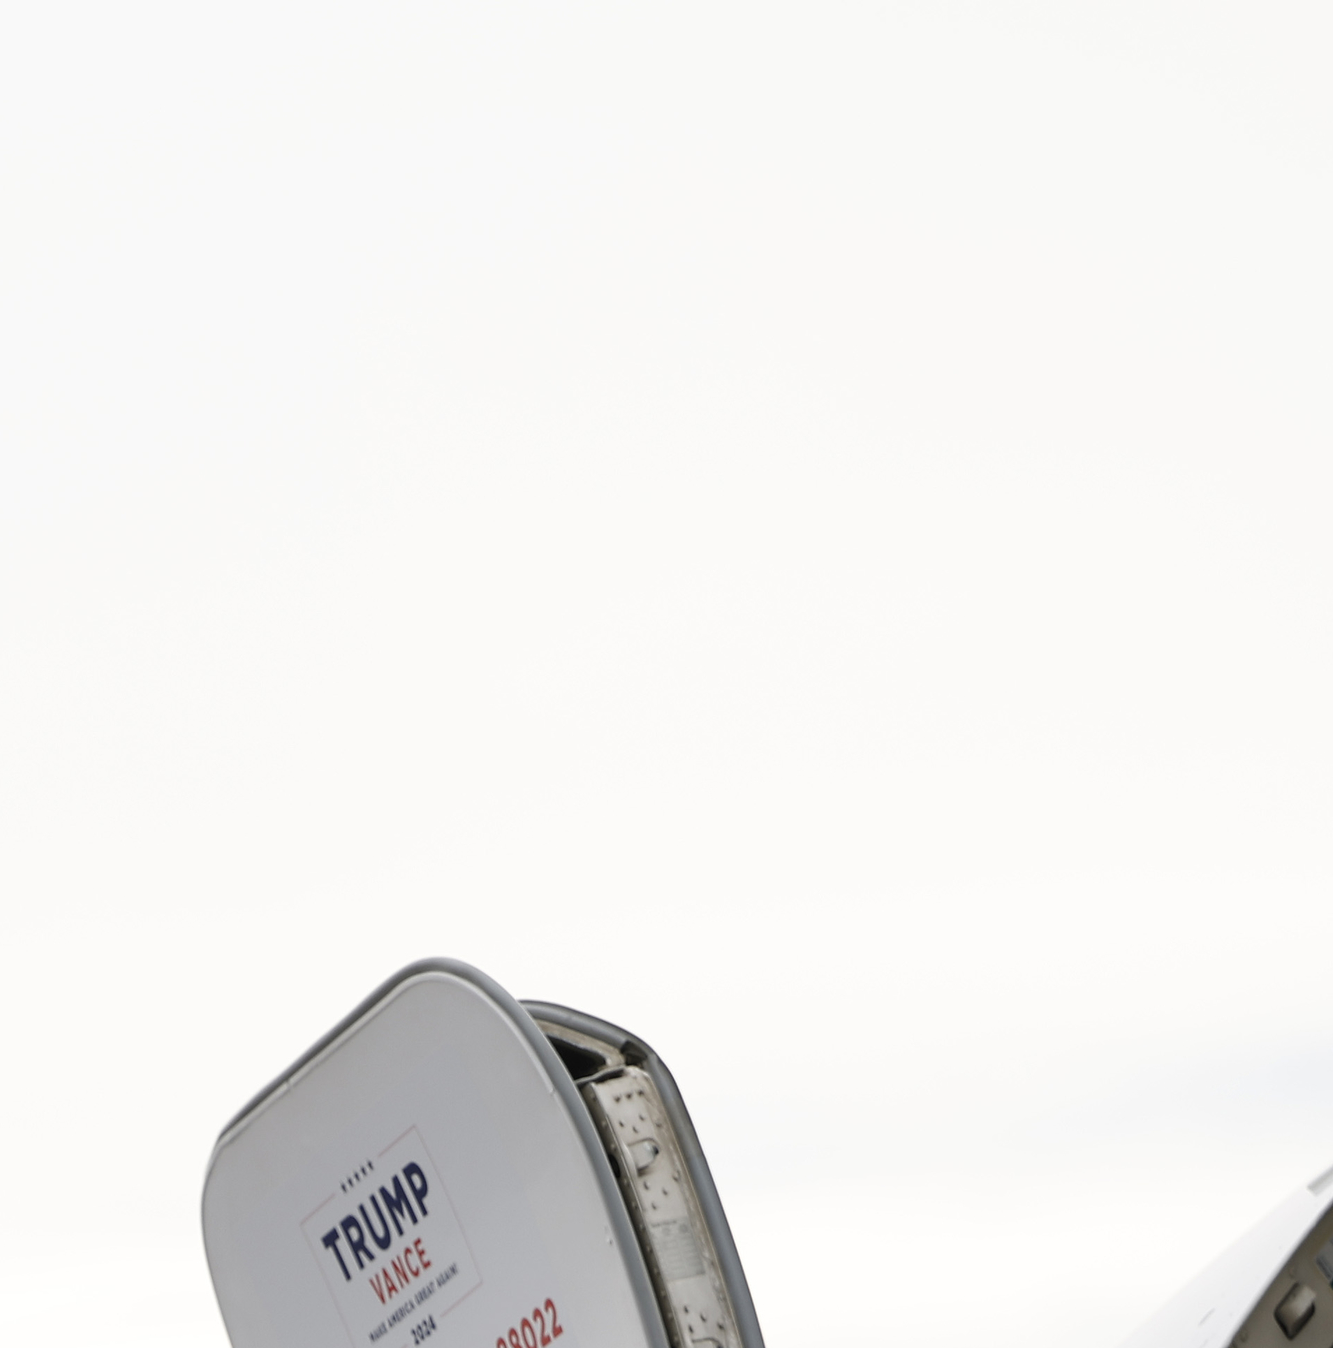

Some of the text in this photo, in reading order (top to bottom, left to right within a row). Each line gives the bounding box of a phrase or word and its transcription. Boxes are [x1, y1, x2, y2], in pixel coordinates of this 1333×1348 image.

[321, 1162, 429, 1281] TRUMP
[369, 1238, 431, 1304] VANCE
[387, 1300, 415, 1328] AMERICA
[414, 1281, 435, 1306] GREAT
[411, 1314, 437, 1346] 2024
